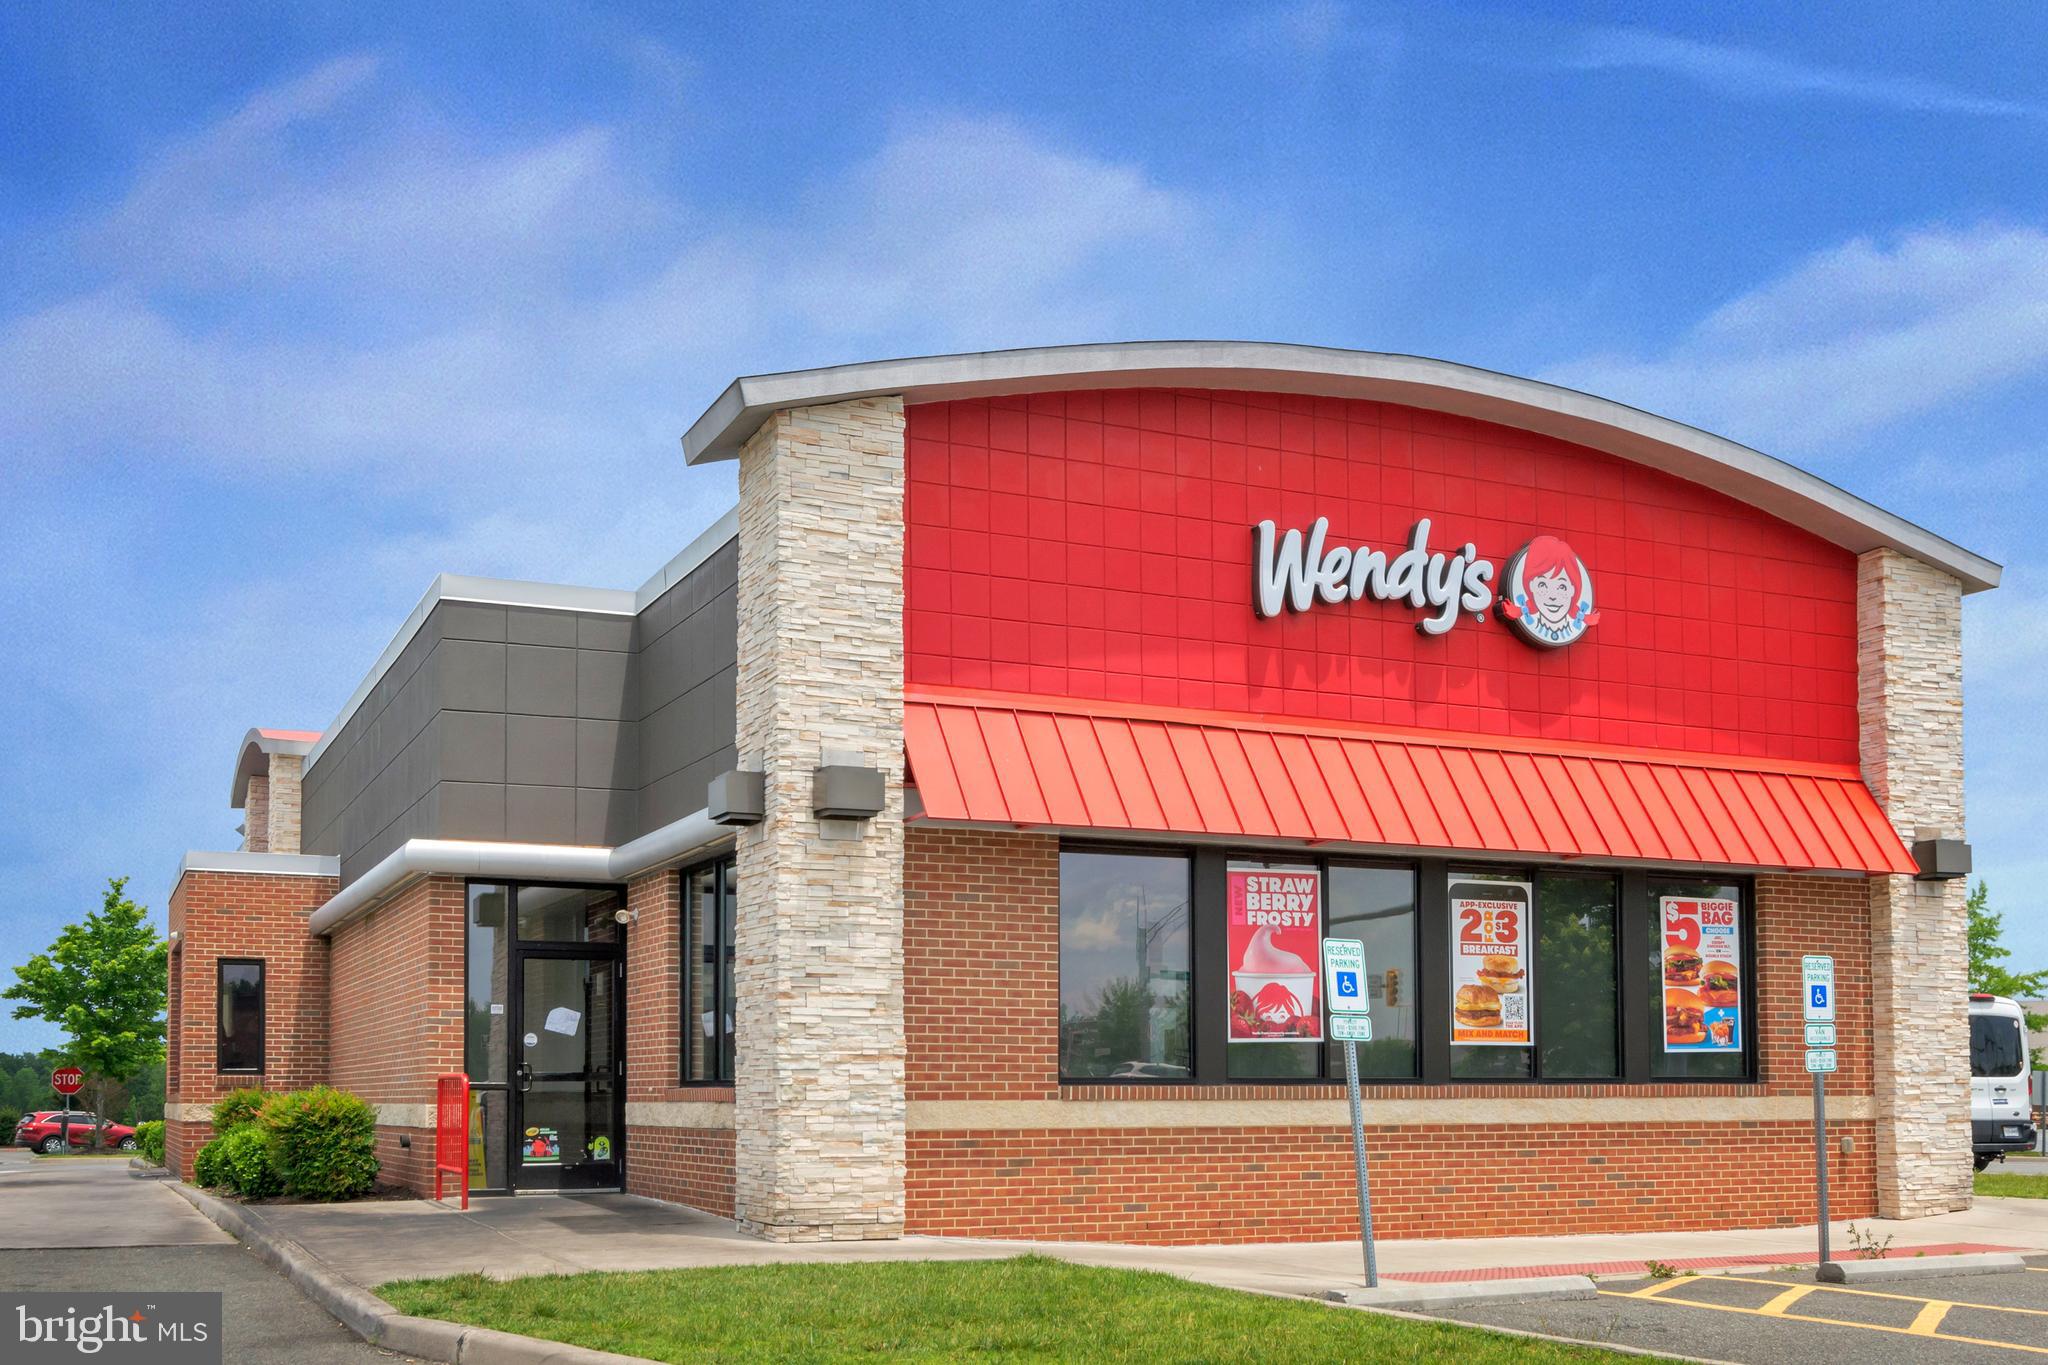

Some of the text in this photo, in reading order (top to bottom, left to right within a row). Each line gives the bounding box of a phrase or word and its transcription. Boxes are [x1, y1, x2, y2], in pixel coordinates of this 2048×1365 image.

[1254, 516, 1494, 636] Wendy's
[1246, 876, 1314, 894] STRAW
[1246, 893, 1314, 912] BERRY
[1459, 900, 1518, 910] APP-EXCLUSIVE
[1701, 902, 1734, 912] BIGGIE
[1247, 911, 1315, 927] FROSTY
[1701, 912, 1734, 925] BAG
[1460, 908, 1482, 943] 2
[1327, 945, 1361, 957] RESERVED
[1462, 945, 1517, 956] BREAKFAST
[1330, 958, 1360, 969] PARKING
[1804, 962, 1831, 972] RESERVED
[1807, 973, 1830, 983] PARKING
